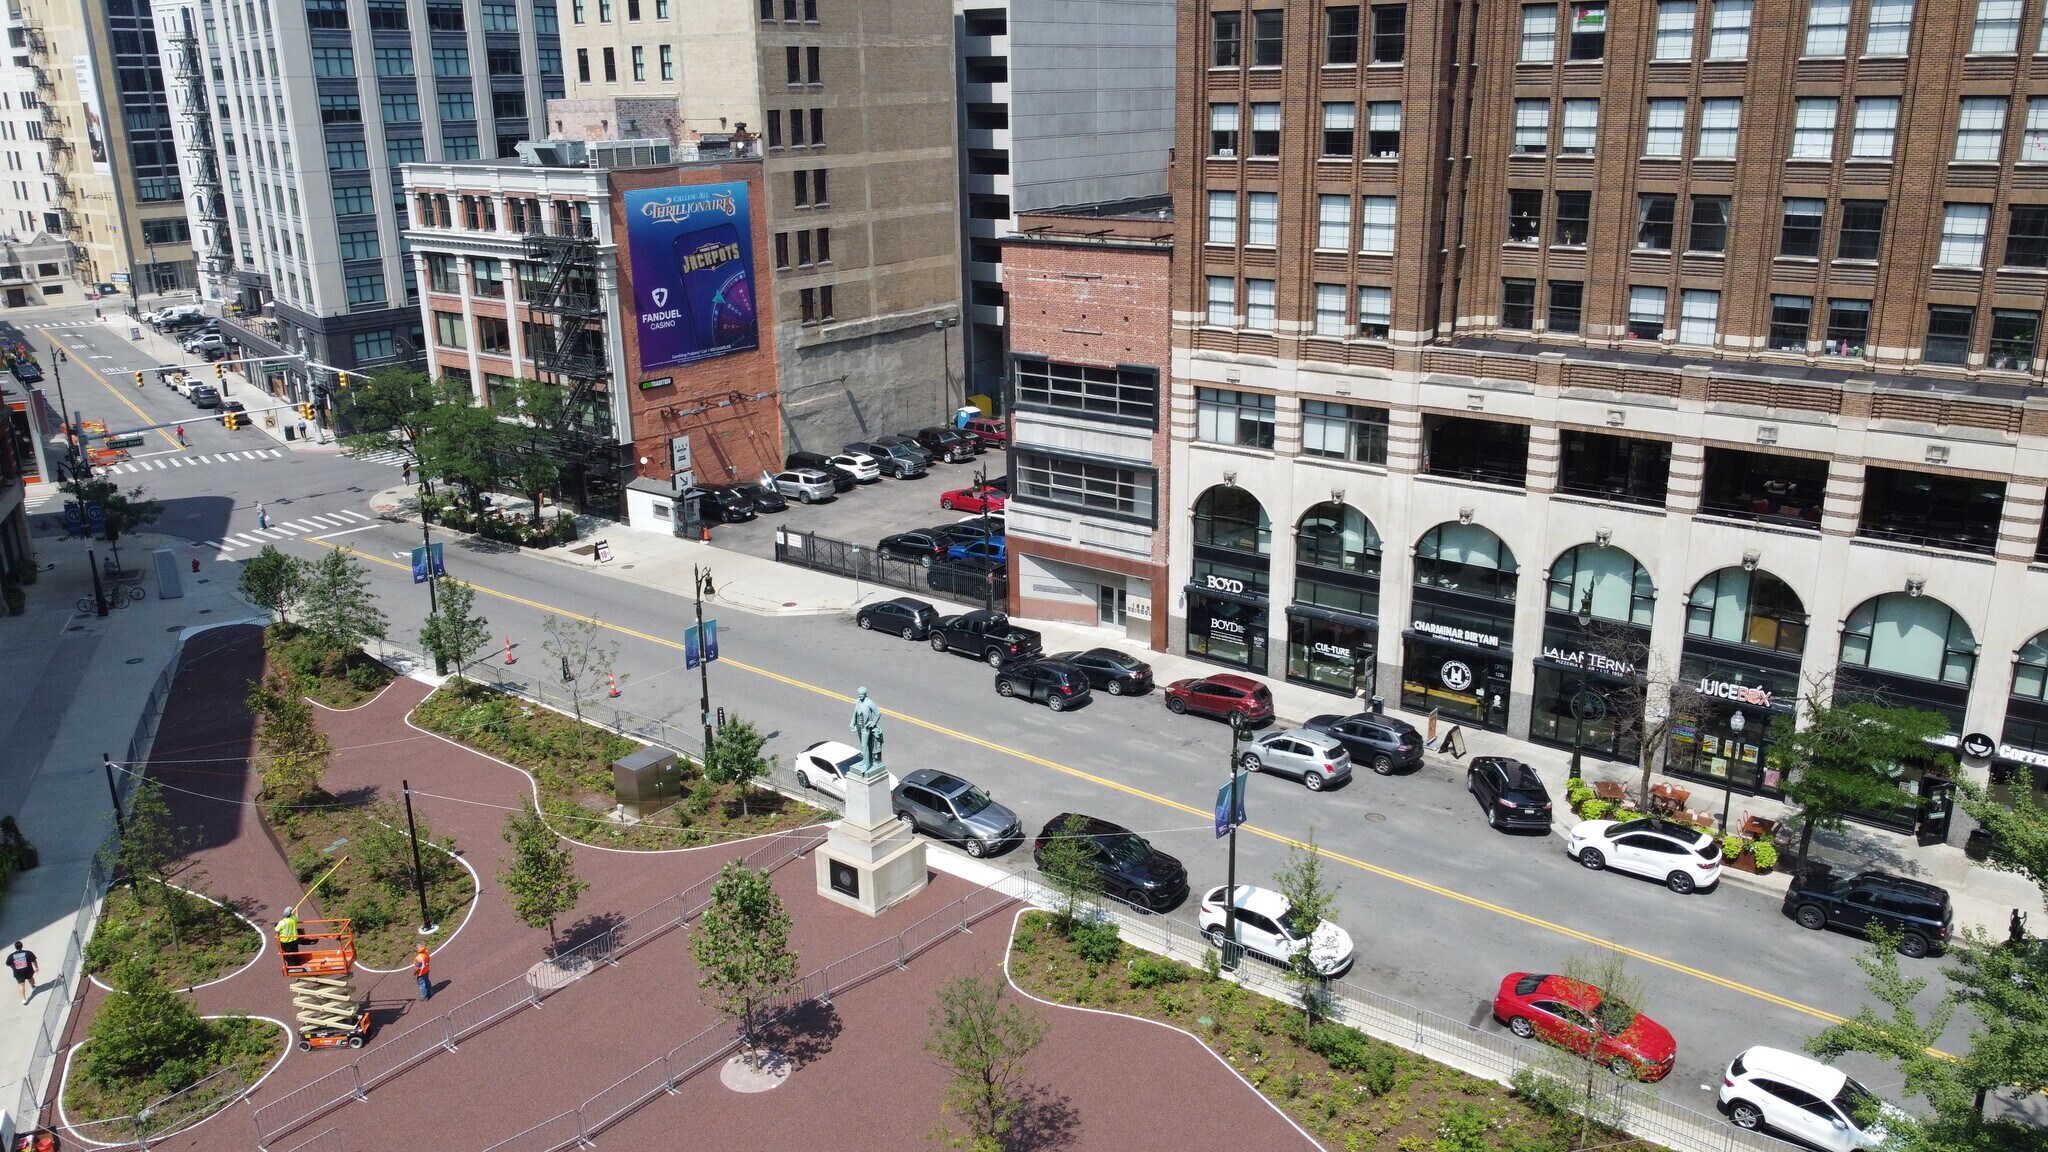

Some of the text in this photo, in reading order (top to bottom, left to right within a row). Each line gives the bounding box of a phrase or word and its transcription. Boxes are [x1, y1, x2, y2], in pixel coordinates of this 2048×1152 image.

[641, 190, 736, 224] THRILLIONAIRES
[683, 242, 740, 274] JACKPOTS
[642, 309, 682, 324] FANDUEL
[650, 320, 676, 330] CASINO
[1207, 576, 1244, 594] BOYD
[1211, 618, 1238, 632] BOYD
[1414, 620, 1498, 646] CHARMINAR BIRYANI
[1556, 660, 1578, 668] PIZZERIA
[1695, 678, 1772, 707] JUICEBOX
[2000, 745, 2048, 767] COFFE
